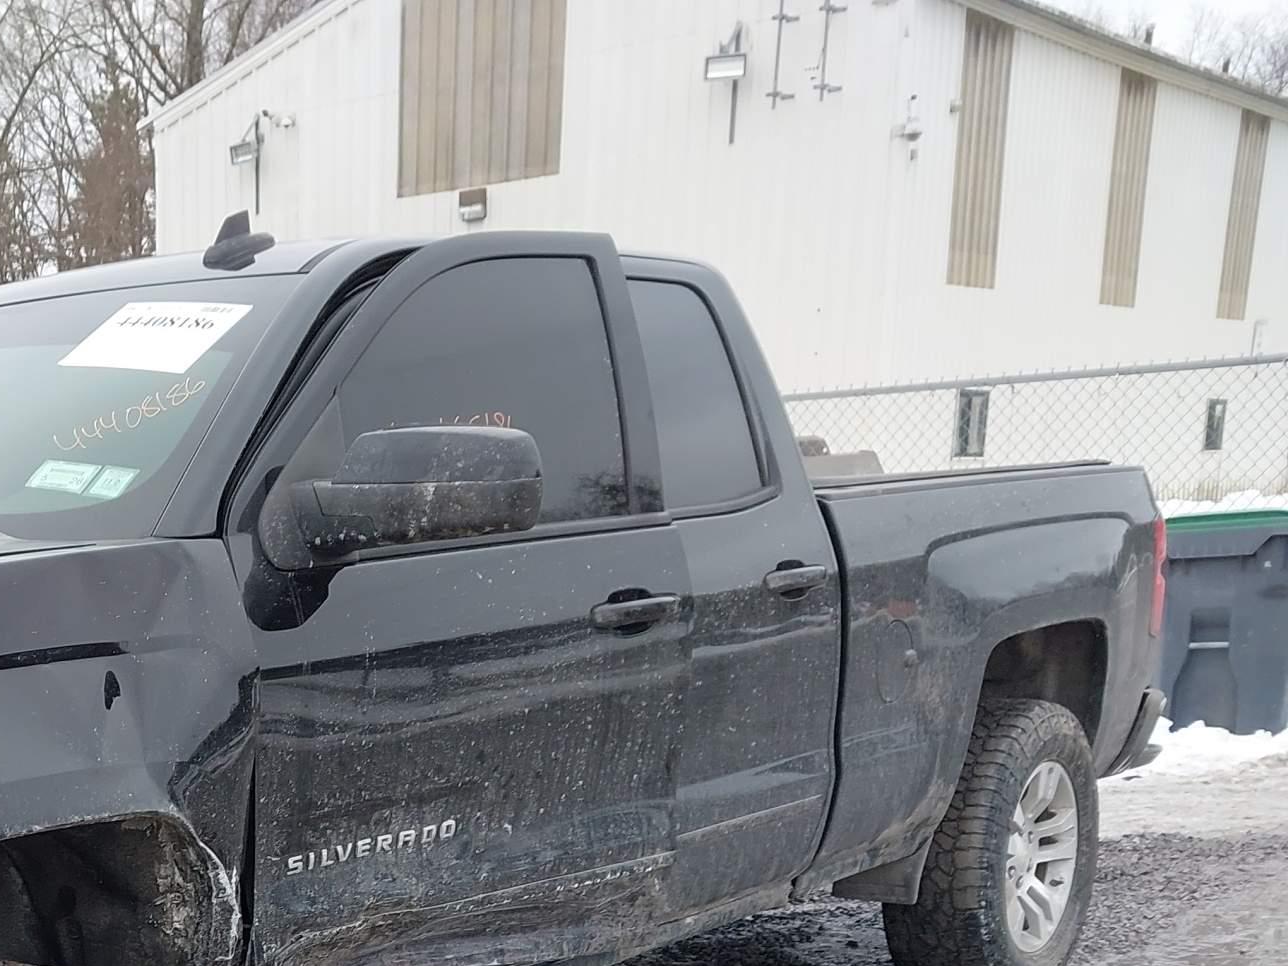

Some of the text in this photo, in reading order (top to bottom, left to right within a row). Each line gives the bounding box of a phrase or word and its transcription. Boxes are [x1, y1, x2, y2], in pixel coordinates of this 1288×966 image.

[116, 316, 215, 329] 44408186
[53, 377, 207, 452] 44408186
[286, 819, 457, 876] SILVERADO
